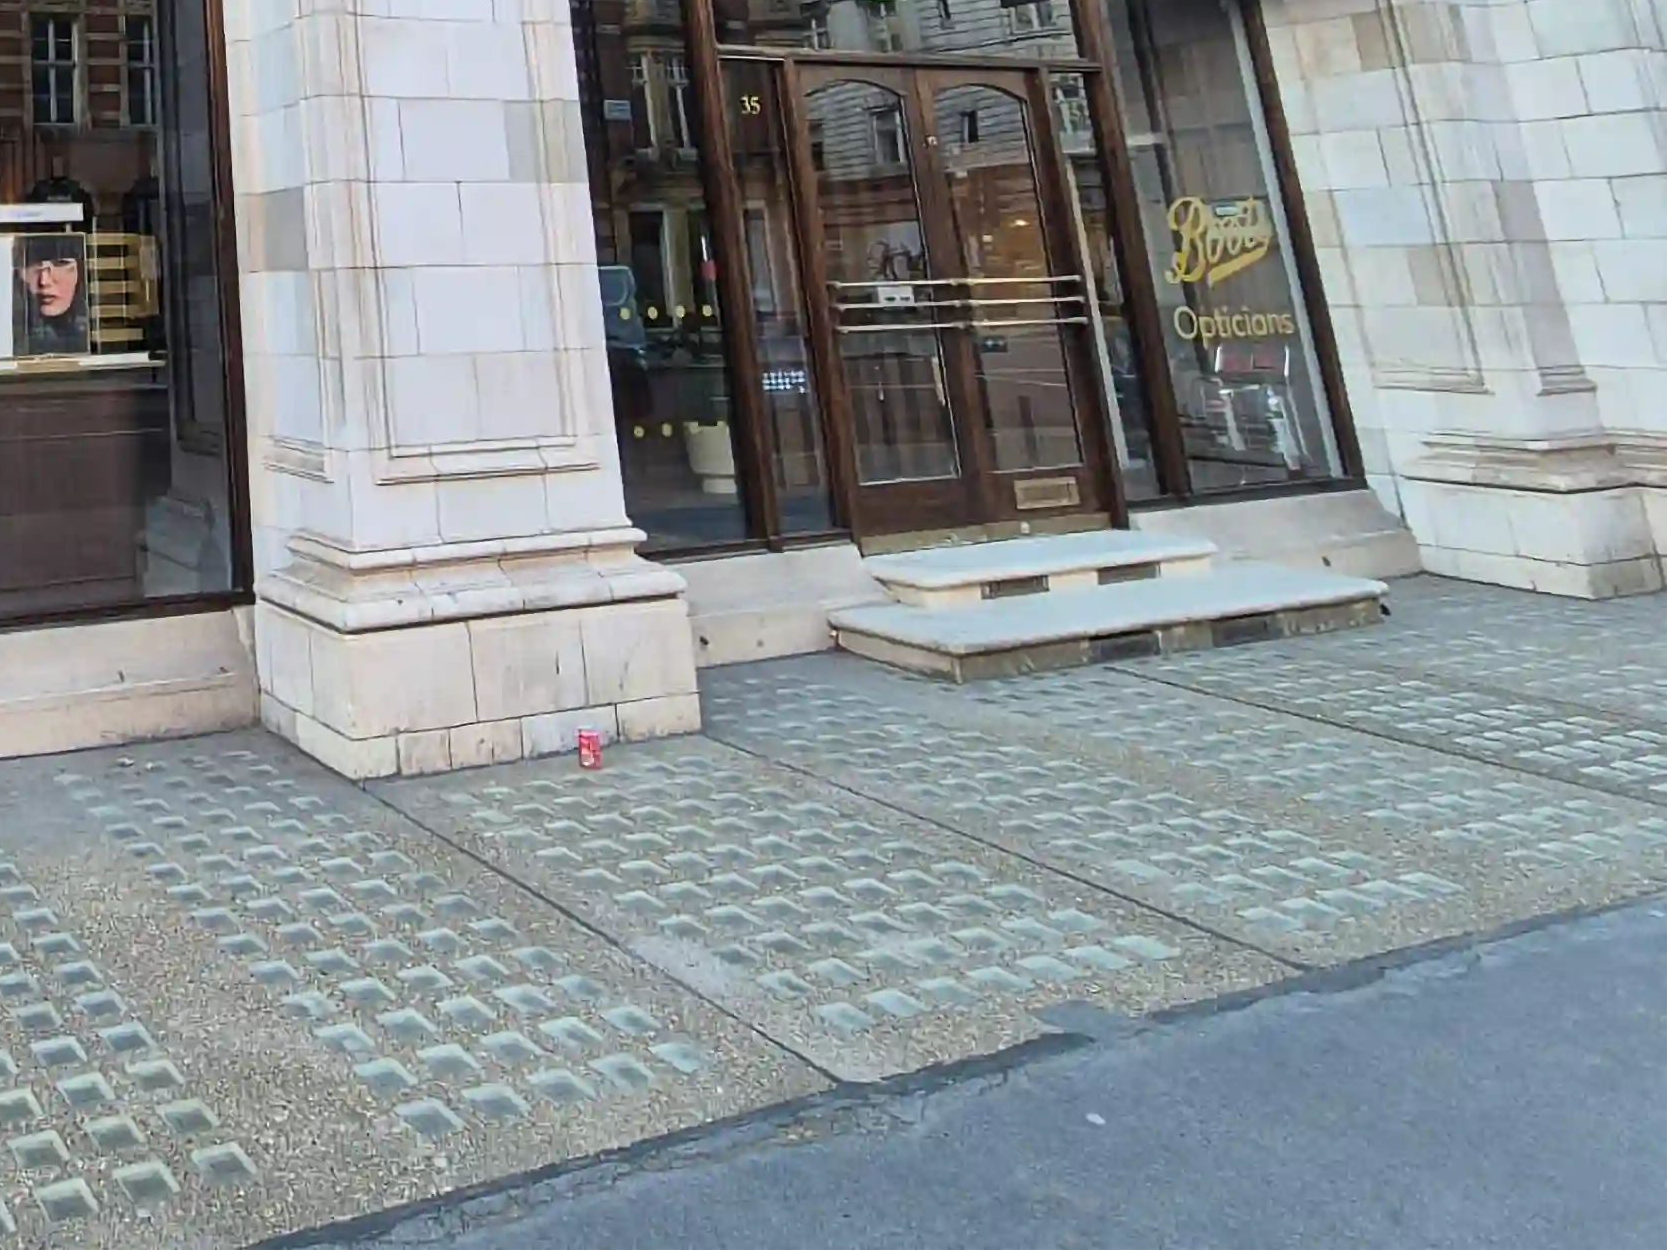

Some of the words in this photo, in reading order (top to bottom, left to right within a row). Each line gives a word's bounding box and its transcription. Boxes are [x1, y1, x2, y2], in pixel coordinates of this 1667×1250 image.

[740, 95, 761, 115] 35
[1165, 196, 1273, 287] Boots
[1173, 305, 1296, 350] Opticians
